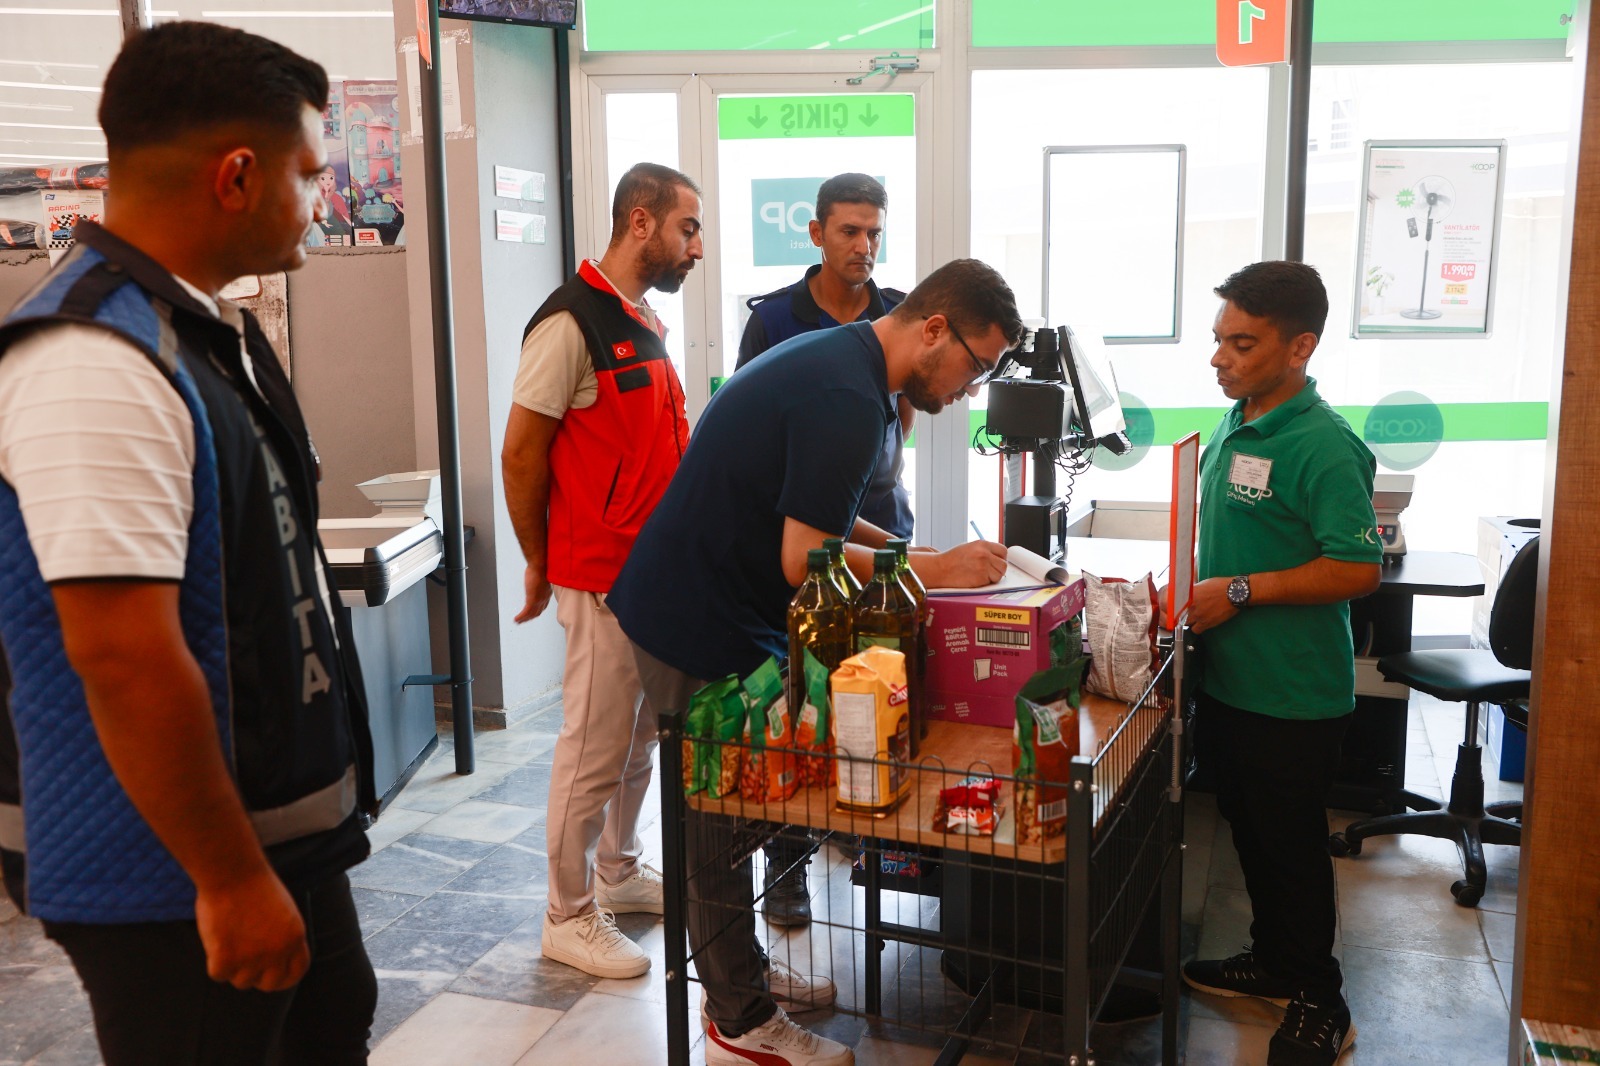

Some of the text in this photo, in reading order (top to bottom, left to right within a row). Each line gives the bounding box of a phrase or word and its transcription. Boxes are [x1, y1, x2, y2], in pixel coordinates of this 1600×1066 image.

[48, 204, 80, 213] RACING
[983, 610, 1007, 619] SÜPER
[993, 663, 1007, 671] Unit
